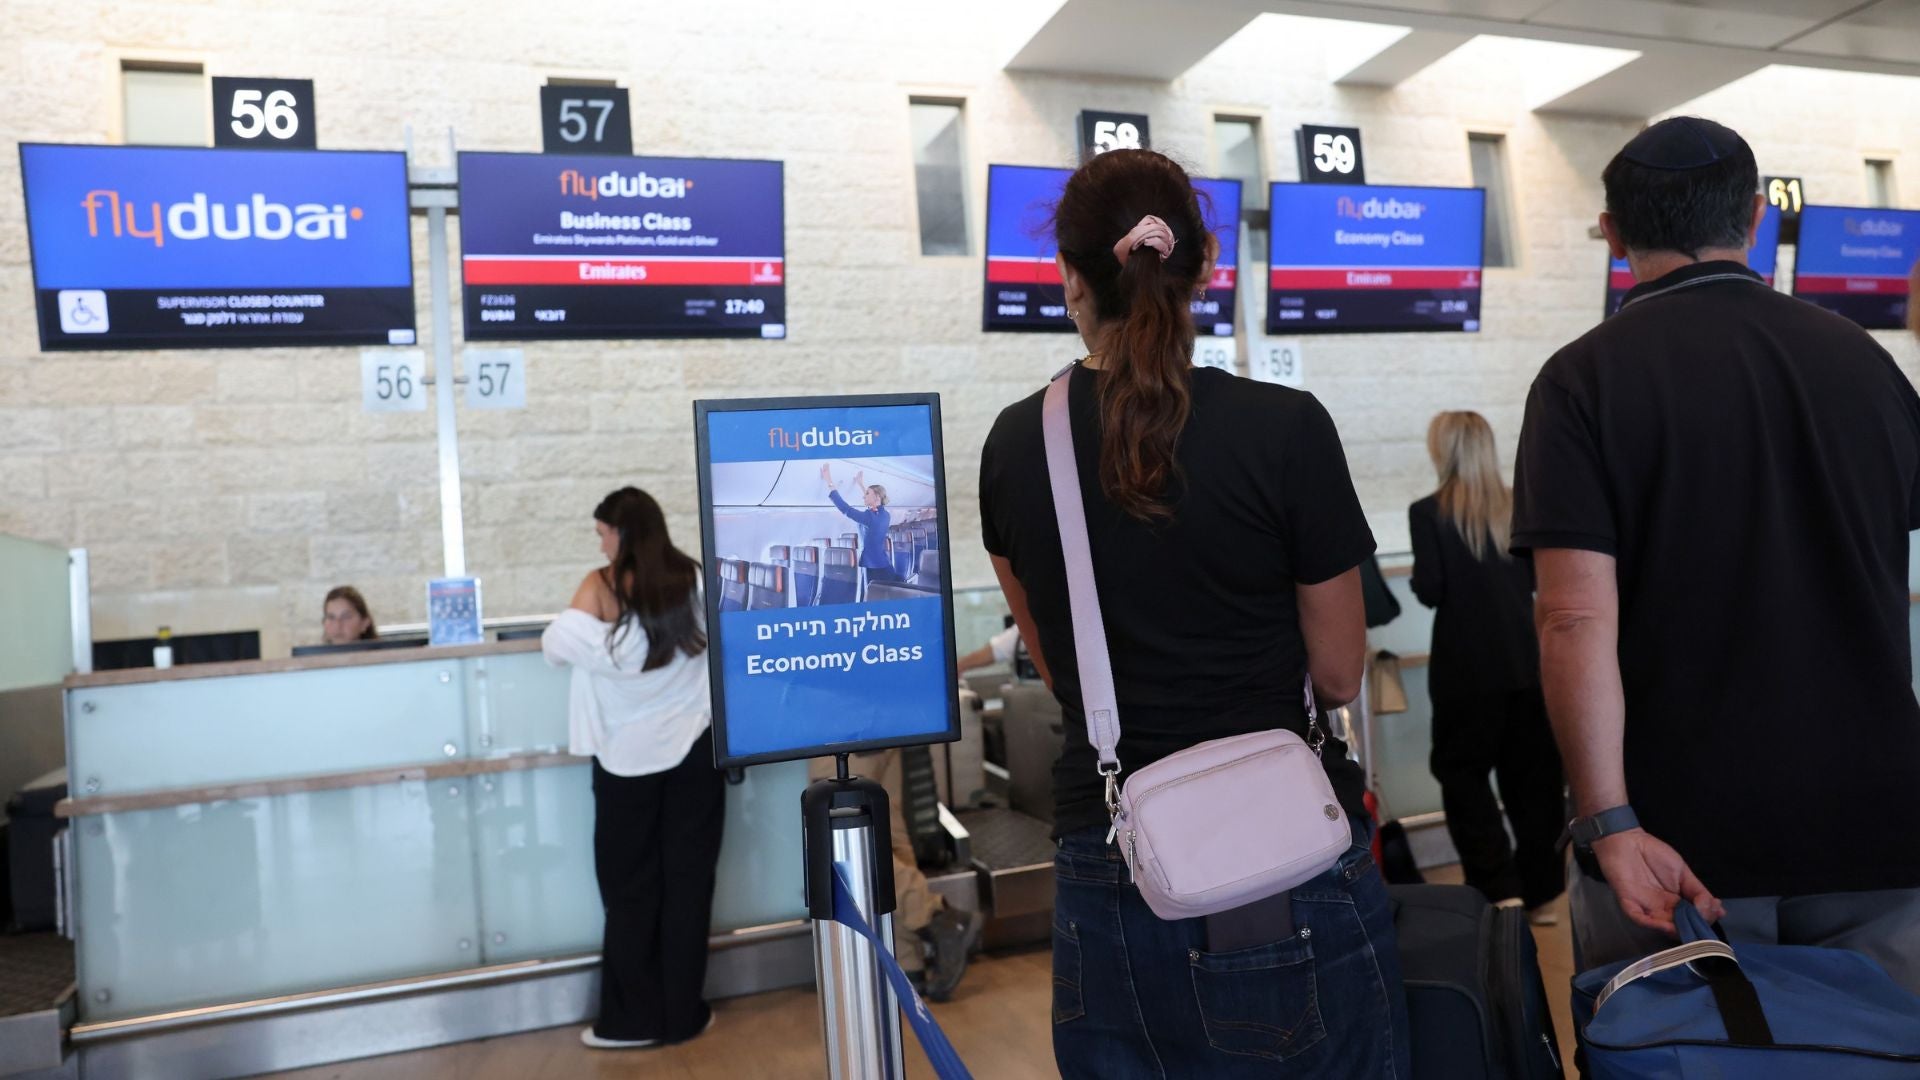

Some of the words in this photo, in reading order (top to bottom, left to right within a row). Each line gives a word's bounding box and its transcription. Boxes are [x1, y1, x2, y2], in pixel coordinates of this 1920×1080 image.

[230, 89, 299, 140] 56
[559, 99, 615, 144] 57
[1094, 120, 1141, 156] 58
[1312, 133, 1357, 175] 59
[559, 169, 694, 201] flydubai
[1768, 178, 1802, 213] 61
[81, 189, 363, 248] flydubai
[559, 210, 642, 231] Business
[642, 211, 693, 232] Class
[1334, 229, 1391, 249] Economy
[578, 261, 648, 281] Emirates
[156, 295, 228, 310] SUPERVISOR
[227, 294, 272, 308] CLOSED
[271, 294, 326, 308] COUNTER
[724, 297, 765, 315] 17:40
[1270, 348, 1294, 377] 59
[376, 364, 413, 400] 56
[478, 361, 511, 397] 57
[767, 426, 880, 452] flydubai
[756, 618, 827, 641] תיירים
[833, 610, 911, 641] מחלקת
[746, 649, 857, 676] Economy
[860, 643, 924, 666] Class
